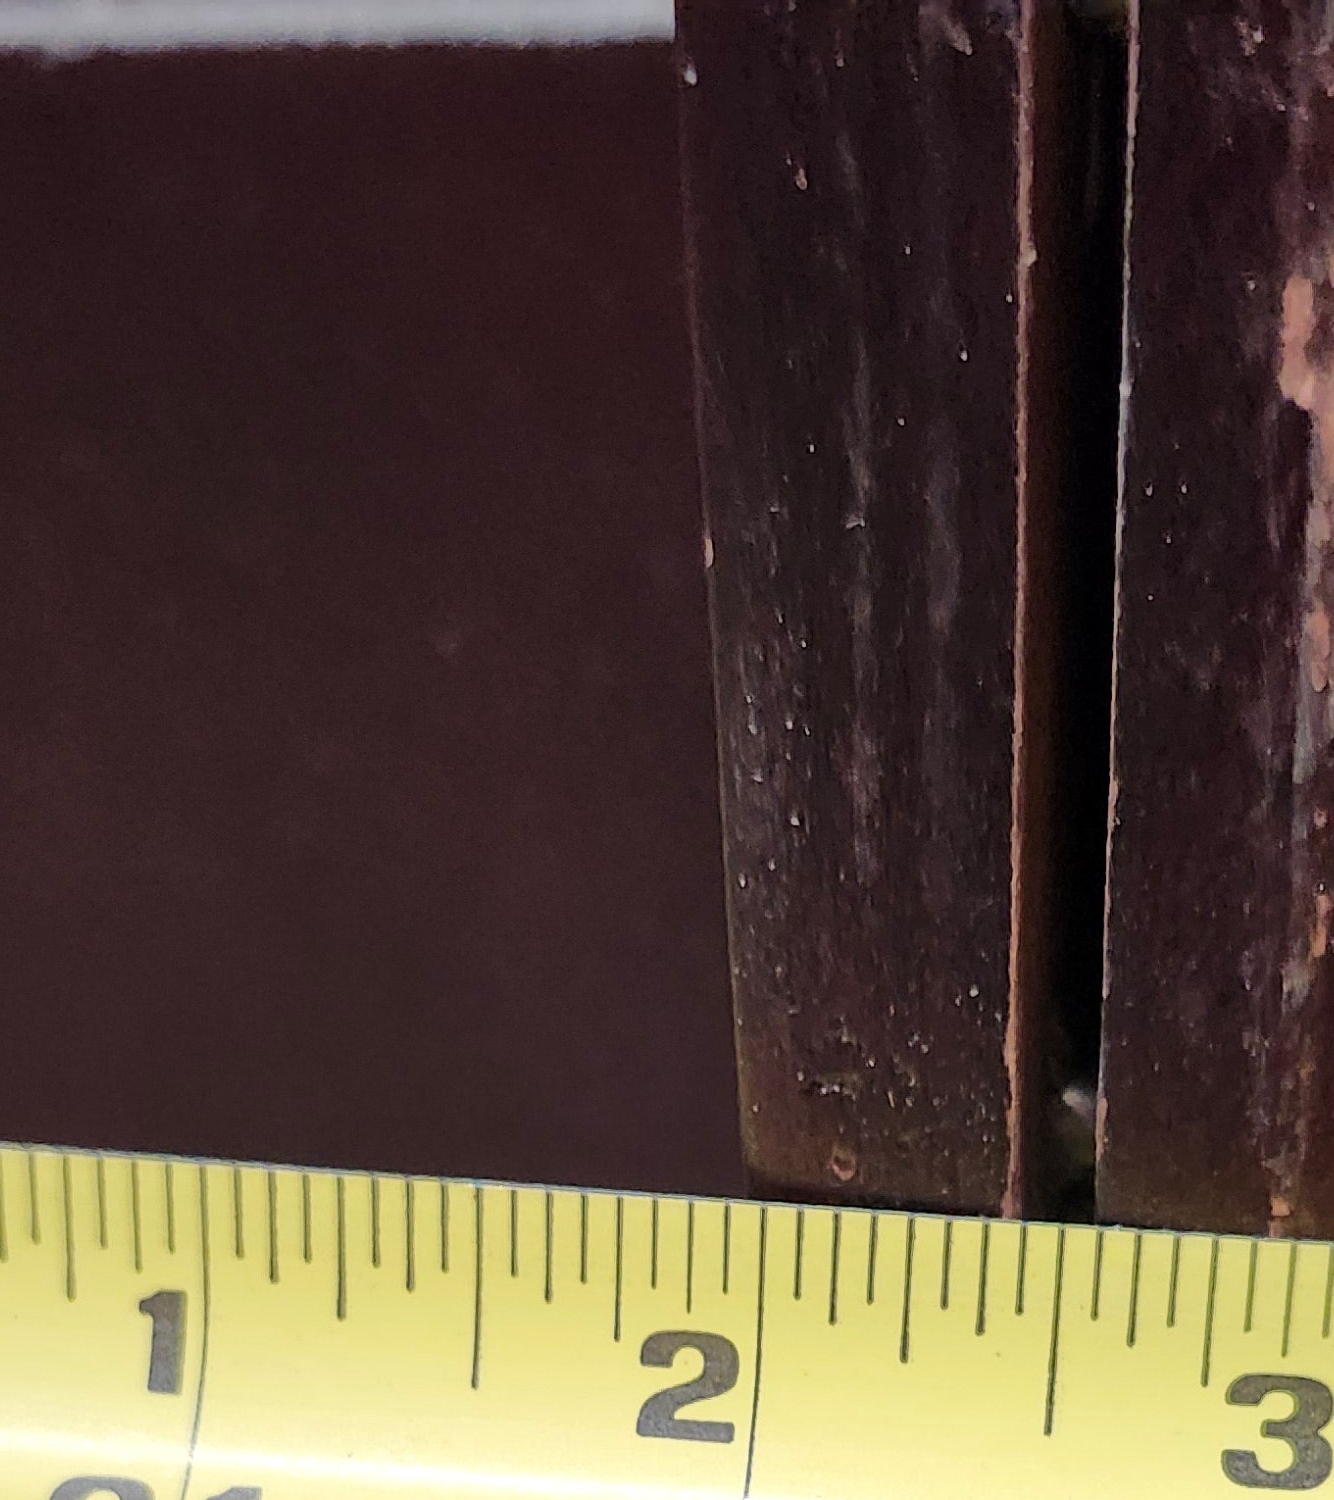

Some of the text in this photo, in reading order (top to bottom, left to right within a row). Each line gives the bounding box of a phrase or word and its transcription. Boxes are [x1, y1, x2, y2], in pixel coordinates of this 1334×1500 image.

[138, 1289, 188, 1395] 1
[635, 1330, 741, 1444] 2
[1220, 1373, 1334, 1491] 3
